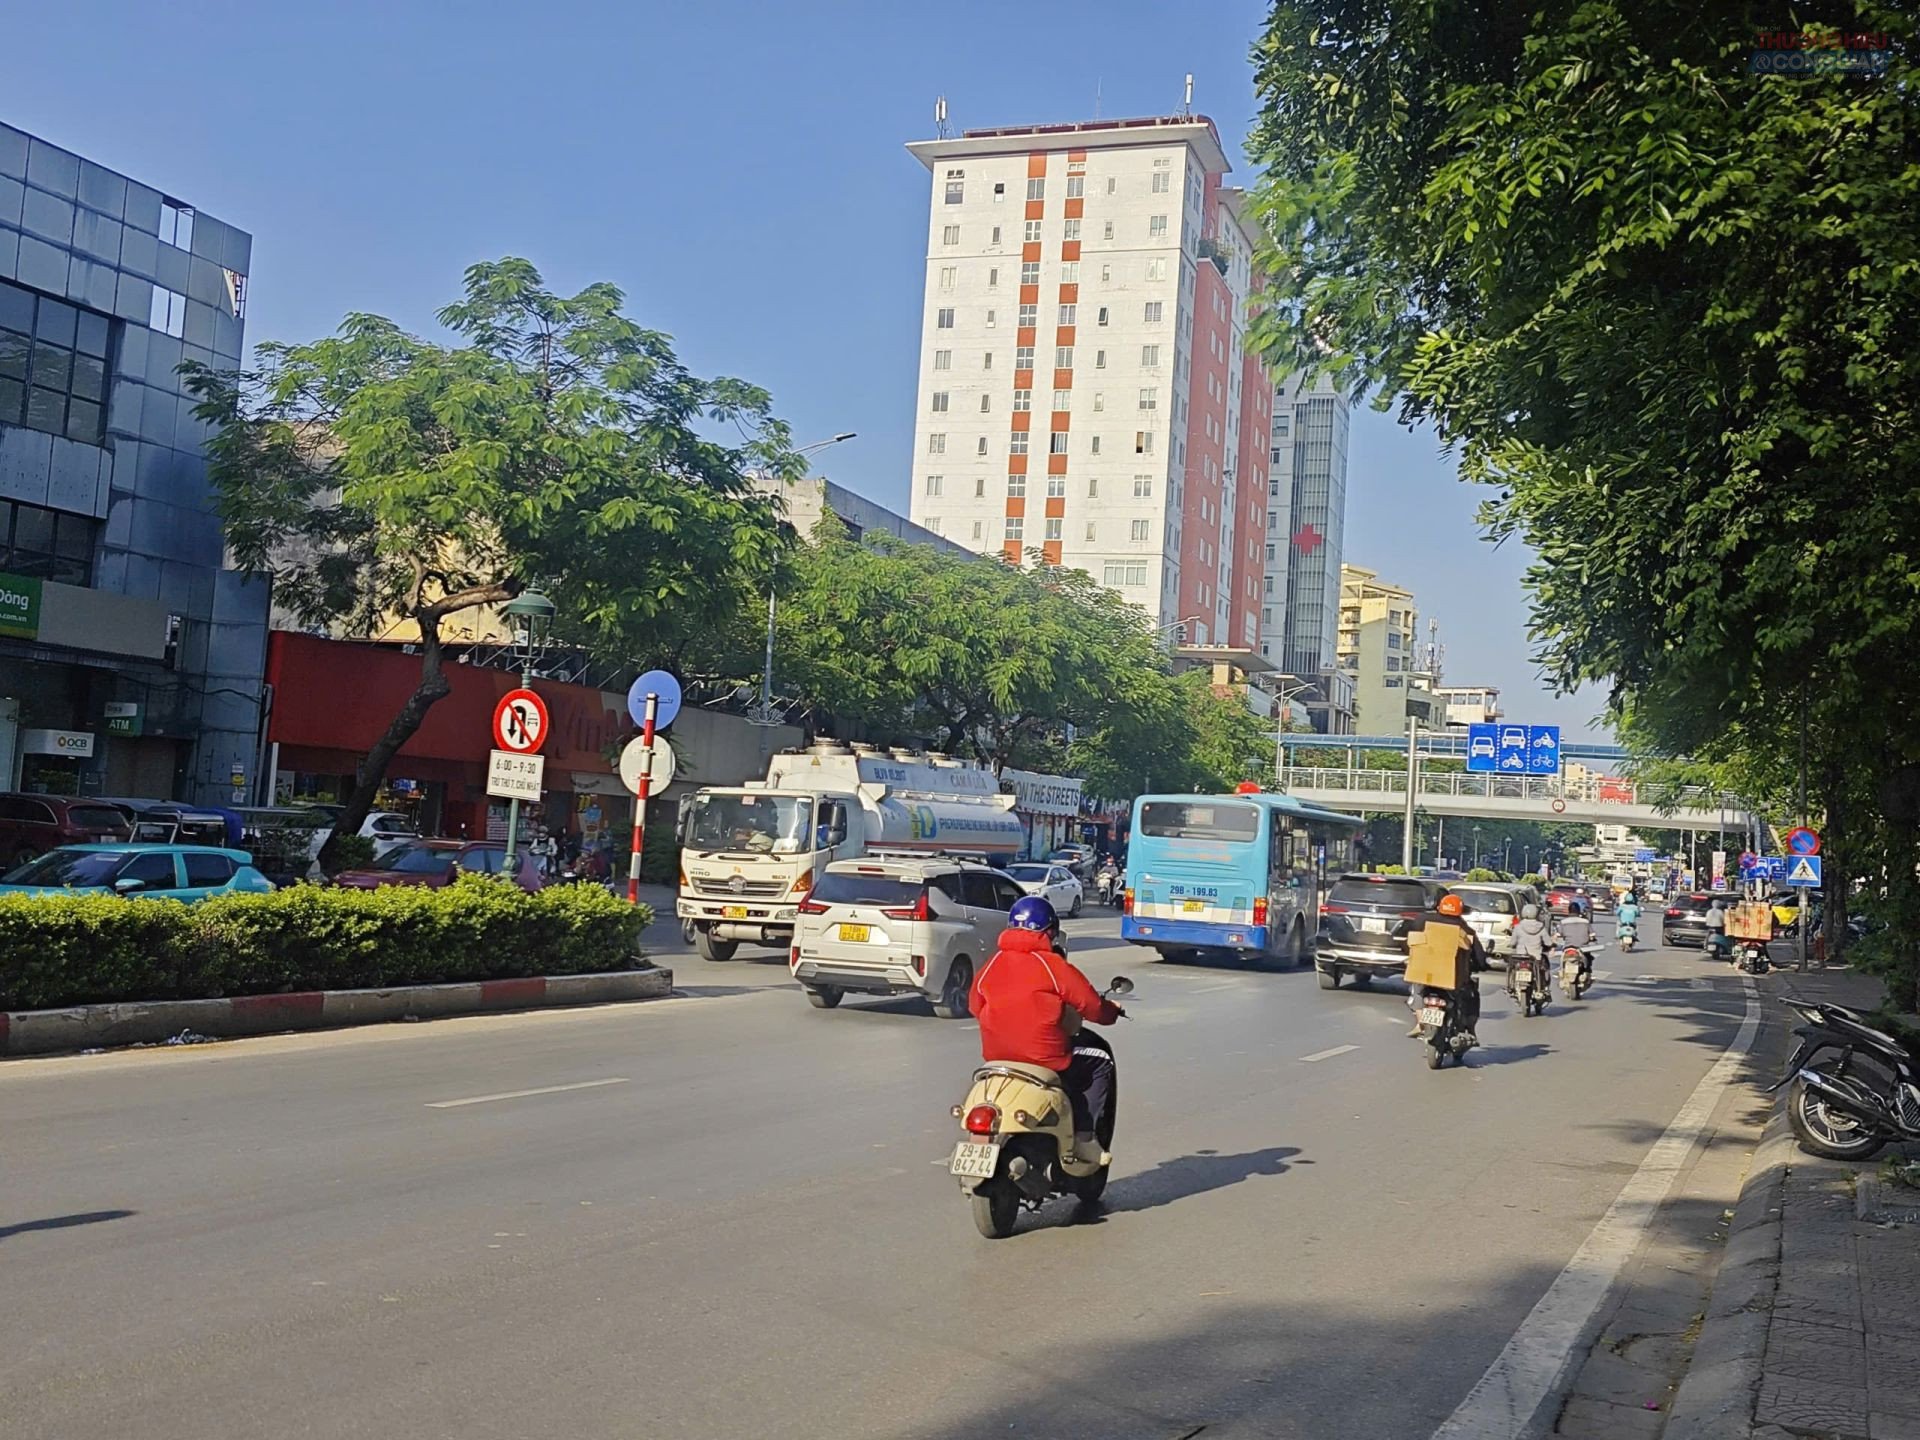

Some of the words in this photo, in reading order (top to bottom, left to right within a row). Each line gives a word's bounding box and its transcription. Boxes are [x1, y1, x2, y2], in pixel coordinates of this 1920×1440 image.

[108, 719, 129, 730] ATM
[67, 738, 87, 747] OCB
[495, 759, 512, 771] 6:00
[519, 762, 536, 774] 9:30
[1029, 782, 1046, 804] THE
[1047, 785, 1080, 807] STREETS
[1170, 885, 1184, 894] 29B
[960, 1144, 992, 1159] 29-AB
[954, 1159, 991, 1175] 847.44
